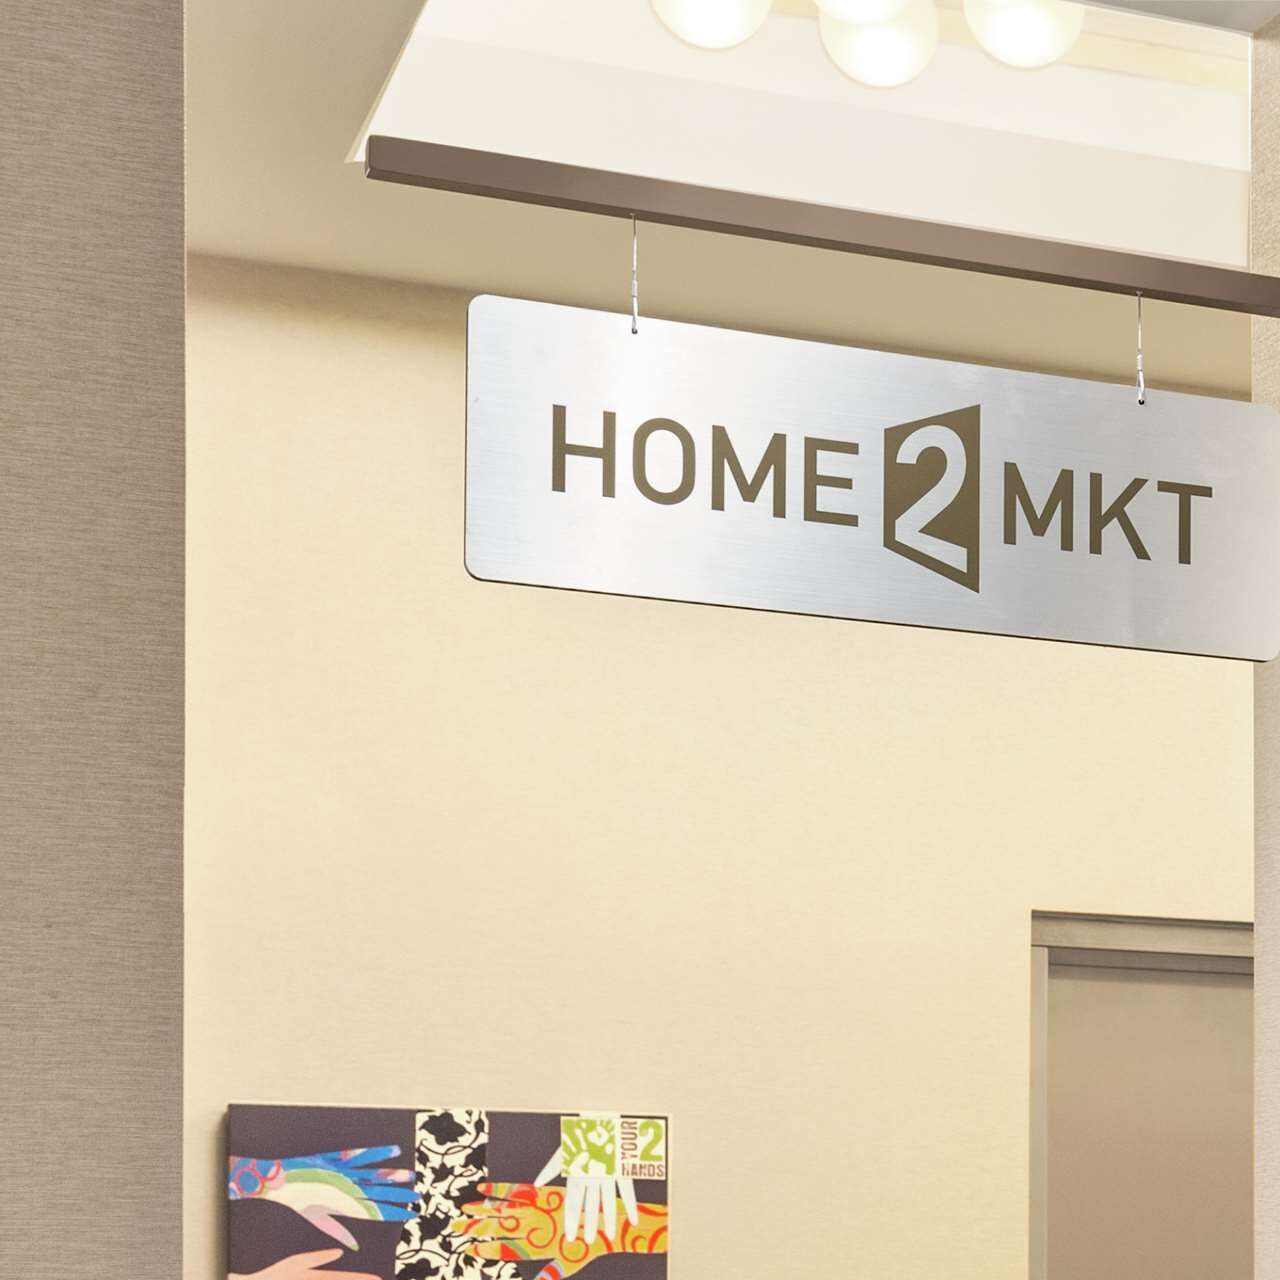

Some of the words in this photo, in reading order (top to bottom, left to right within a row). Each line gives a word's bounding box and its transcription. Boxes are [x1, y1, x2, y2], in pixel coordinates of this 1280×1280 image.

[551, 404, 859, 527] HOME
[892, 424, 970, 574] 2
[1003, 461, 1213, 566] MKT
[621, 1121, 637, 1160] YOUR
[639, 1120, 663, 1161] 2
[621, 1163, 665, 1177] HANDS
